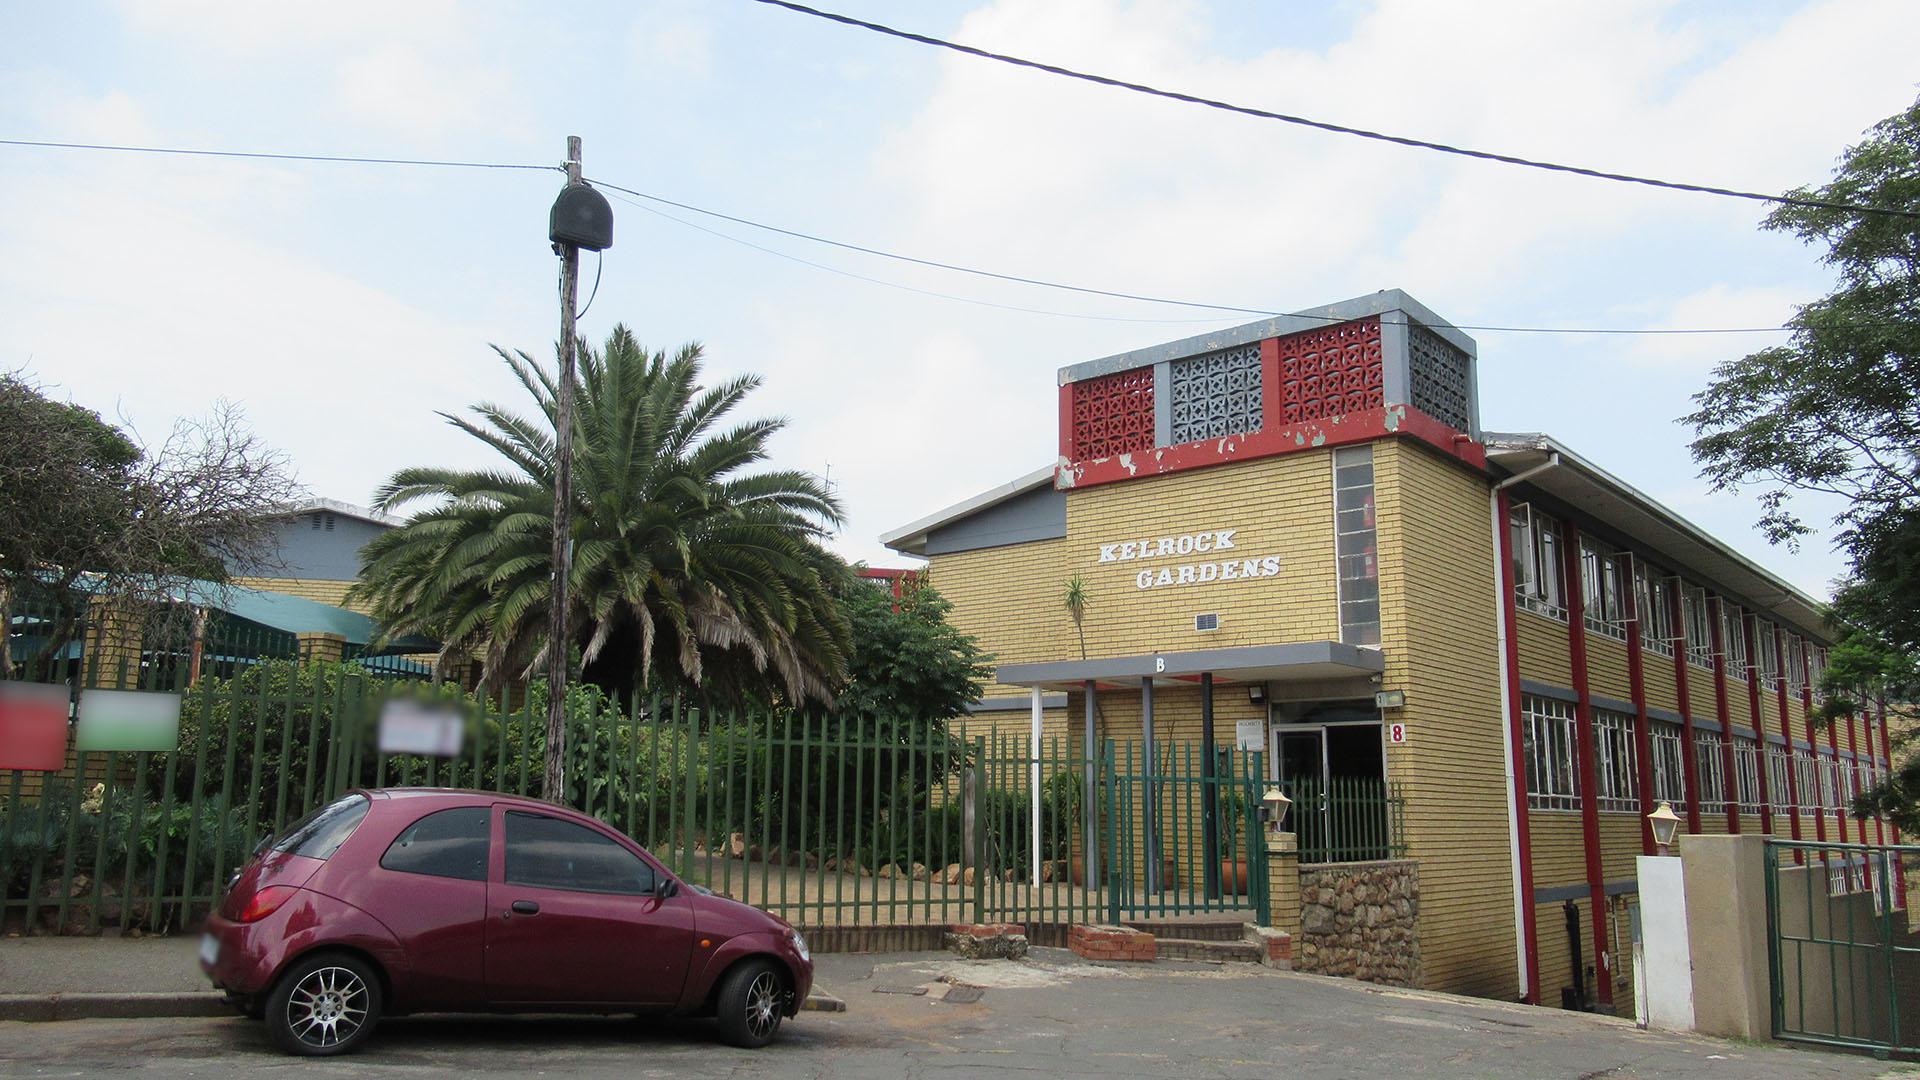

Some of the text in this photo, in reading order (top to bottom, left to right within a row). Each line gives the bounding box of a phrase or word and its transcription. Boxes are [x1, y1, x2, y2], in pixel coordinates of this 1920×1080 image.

[1098, 529, 1237, 563] KELROCK
[1136, 556, 1281, 589] GARDENS
[1156, 657, 1165, 673] B
[1392, 725, 1403, 742] 8
